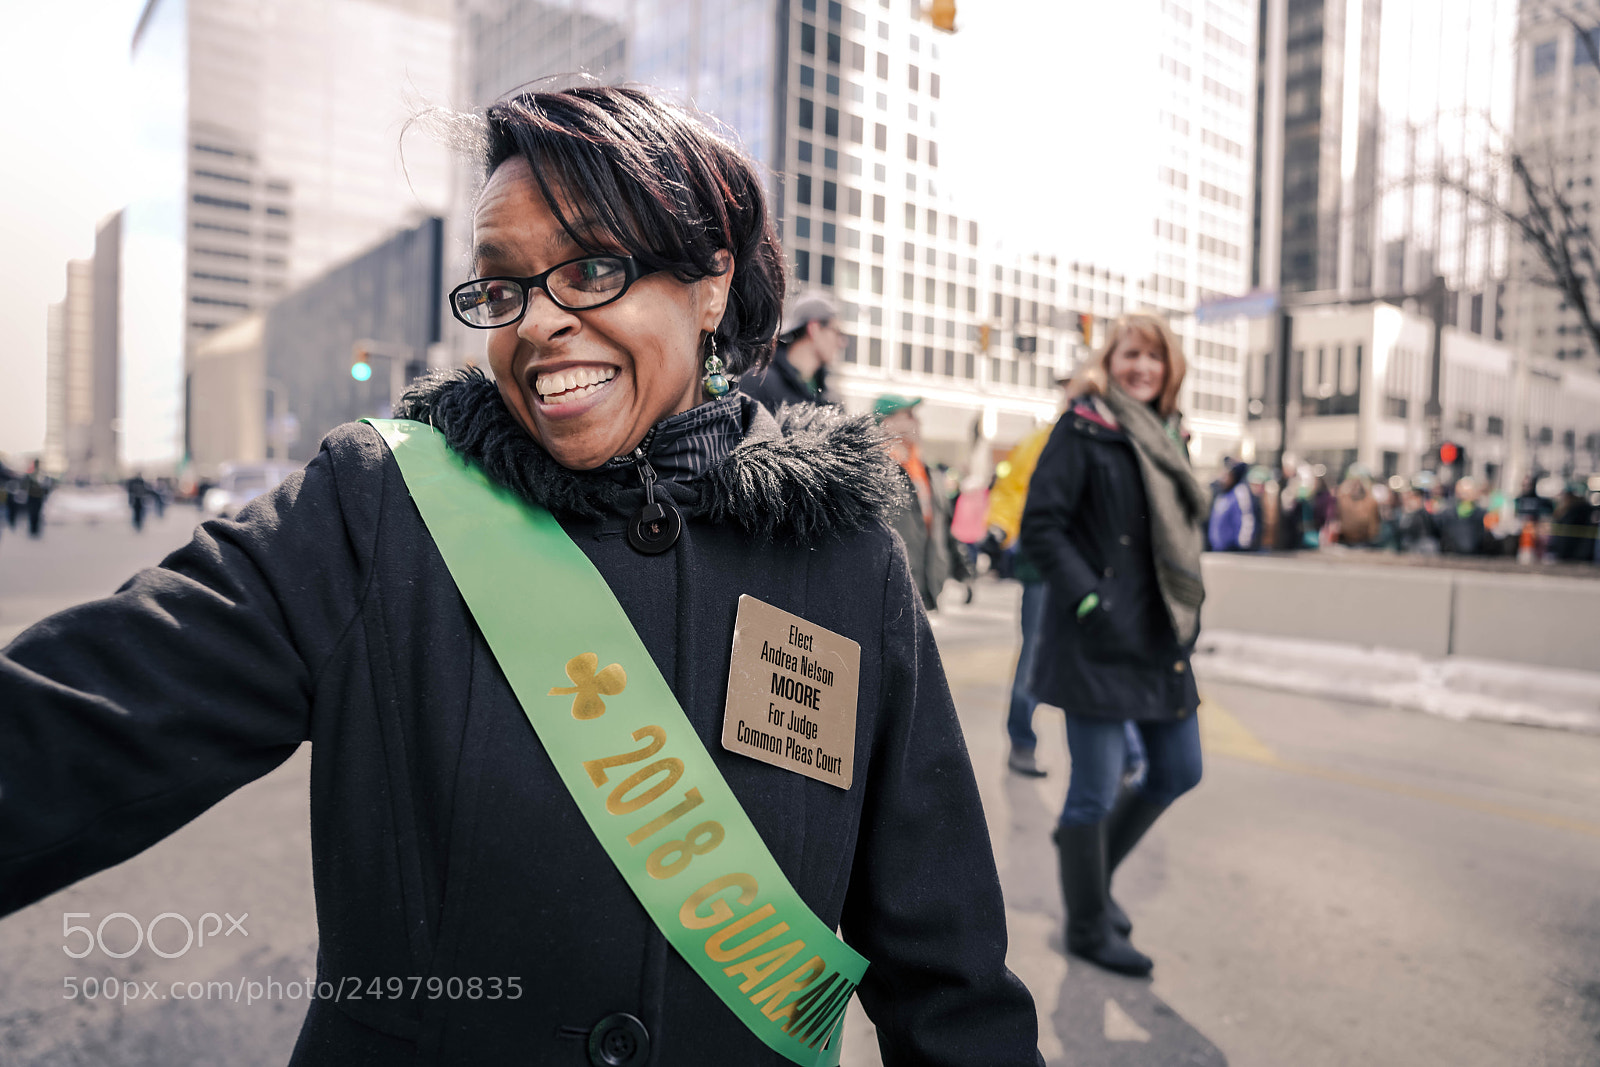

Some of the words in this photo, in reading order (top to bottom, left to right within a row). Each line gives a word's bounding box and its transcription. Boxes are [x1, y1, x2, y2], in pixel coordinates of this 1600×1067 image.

[789, 624, 813, 652] Elect
[760, 640, 797, 672] Andrea
[800, 655, 834, 687] Nelson
[771, 672, 821, 711] MOORE
[768, 702, 785, 726] For
[787, 710, 818, 739] Judge
[737, 719, 782, 755] Common
[785, 736, 813, 766] Pleas
[815, 747, 842, 776] Court
[582, 724, 726, 880] 2018
